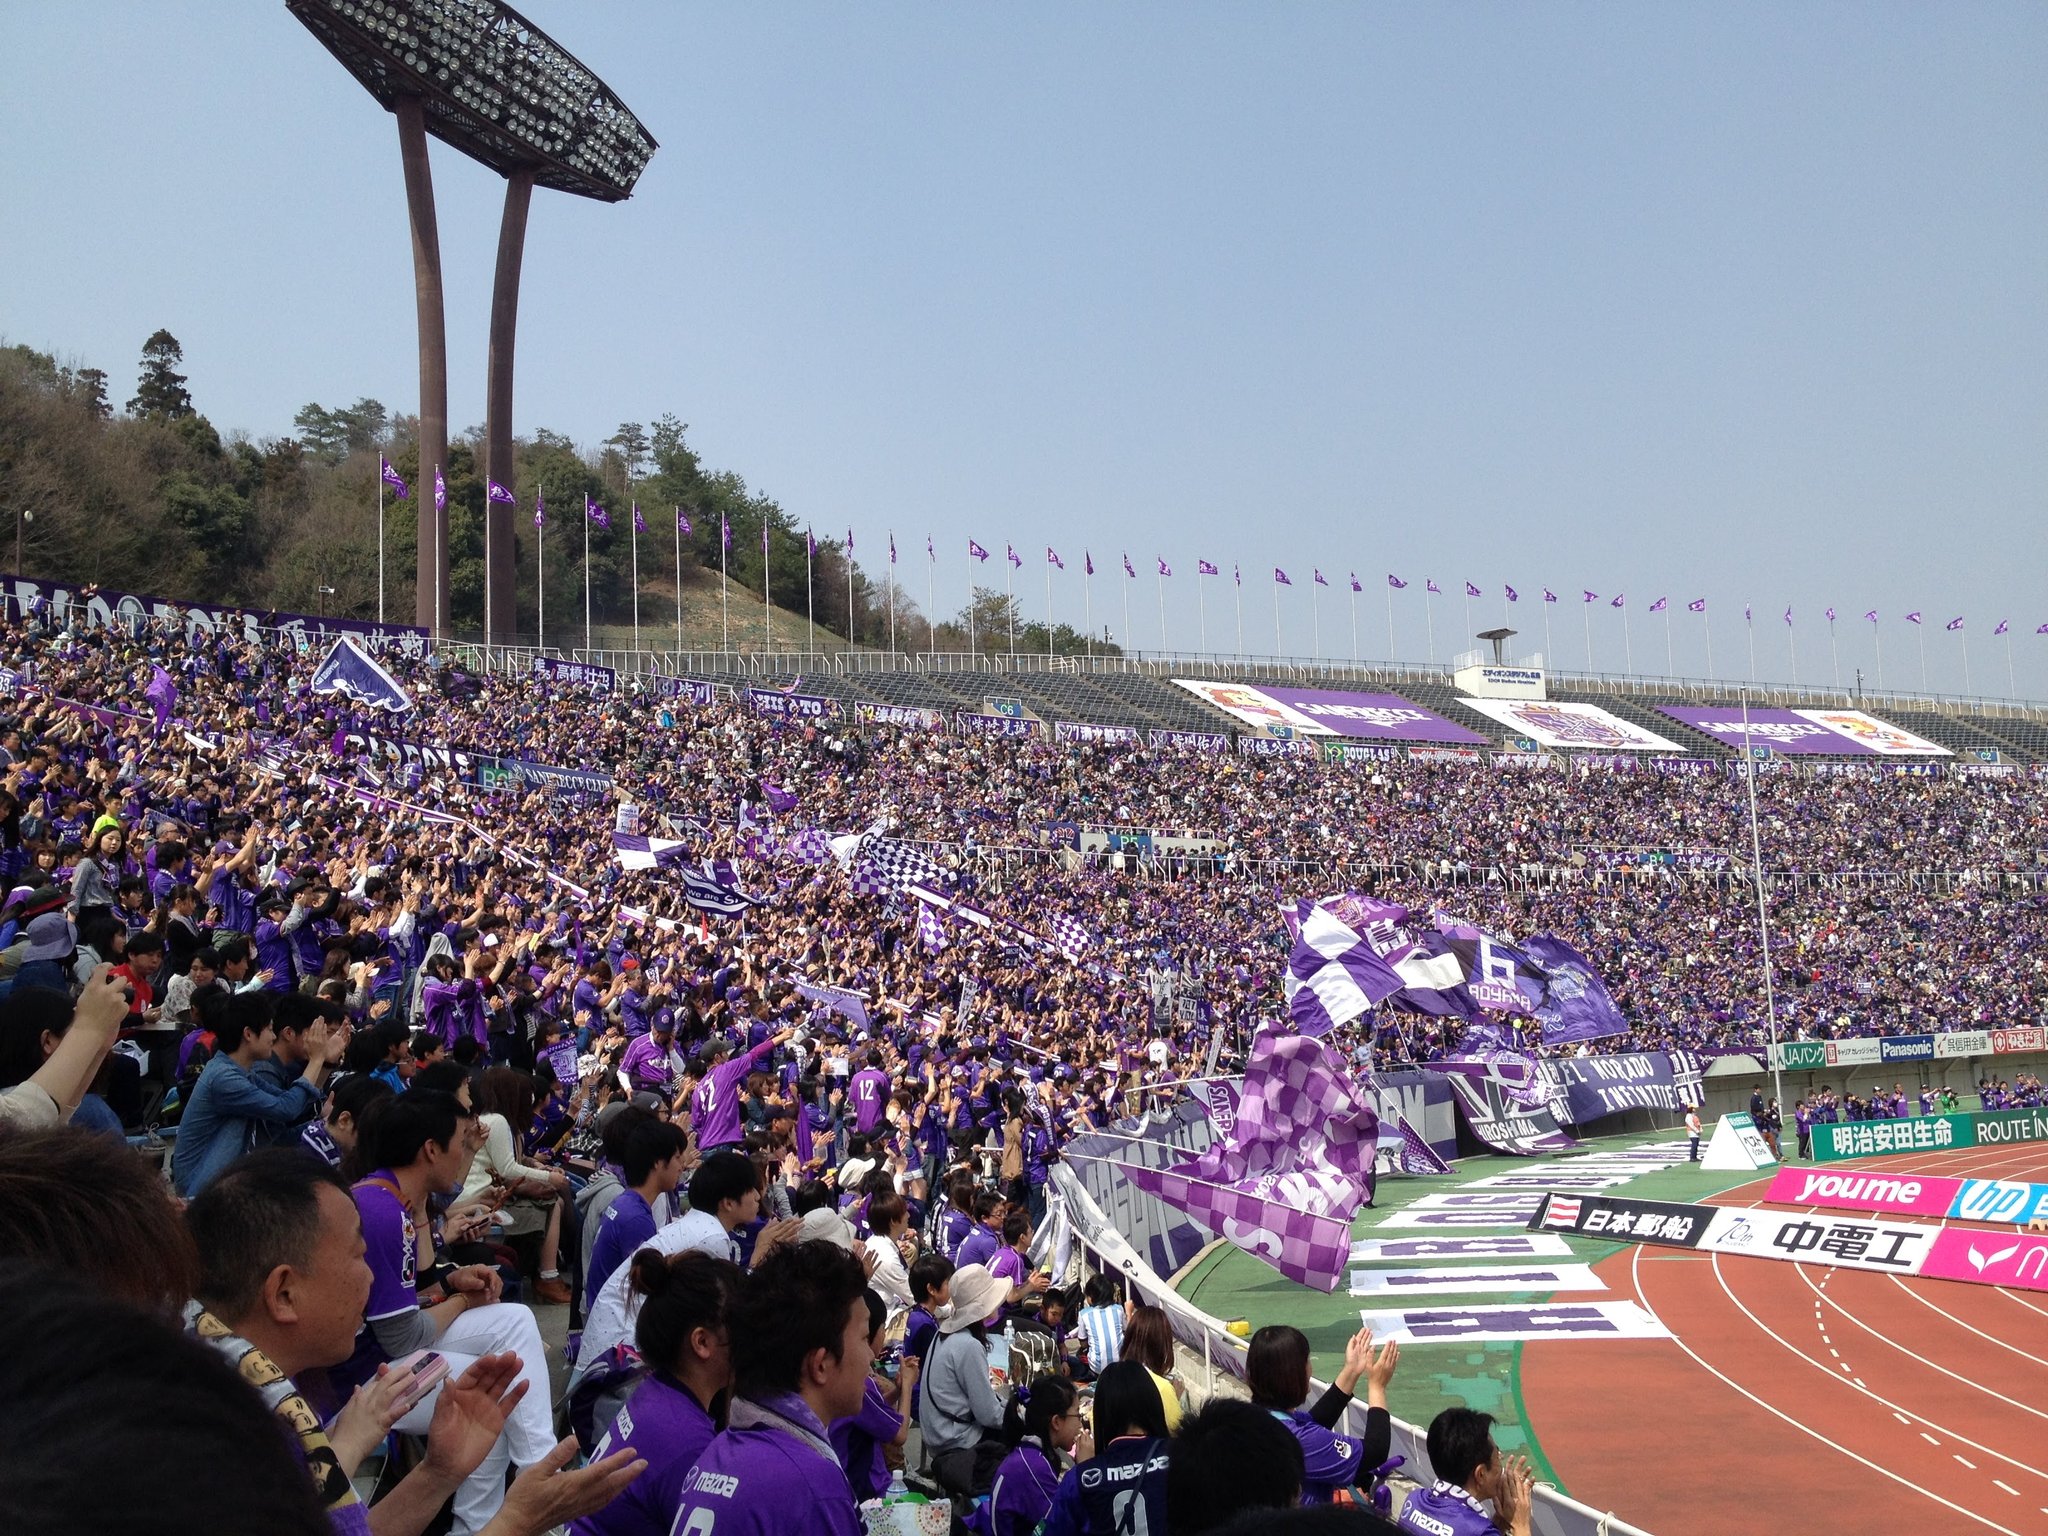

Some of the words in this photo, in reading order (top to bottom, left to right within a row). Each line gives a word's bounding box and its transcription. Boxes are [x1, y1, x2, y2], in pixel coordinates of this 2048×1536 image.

[556, 664, 609, 689] 高橋壮也
[1000, 704, 1014, 716] C6
[1273, 727, 1286, 737] C5
[1344, 746, 1390, 761] DOUGLAS
[1519, 741, 1531, 750] C4
[1754, 750, 1765, 758] C3
[1980, 751, 1992, 761] C2
[1882, 1041, 1932, 1057] Panasonic
[1947, 1037, 1987, 1052] 呉信用金庫
[1785, 1046, 1824, 1065] JAバンク
[1590, 1055, 1654, 1083] MORADO
[858, 1079, 874, 1100] 12
[1475, 1119, 1541, 1141] HIROSHIMA
[1832, 1117, 1952, 1155] 明治安田生命
[1977, 1118, 2031, 1143] ROUTE
[1965, 1180, 2025, 1221] hp
[1582, 1209, 1694, 1240] 日本郵船
[1773, 1221, 1923, 1266] 中電工
[693, 1471, 739, 1499] mazda
[1409, 1510, 1454, 1536] mazda
